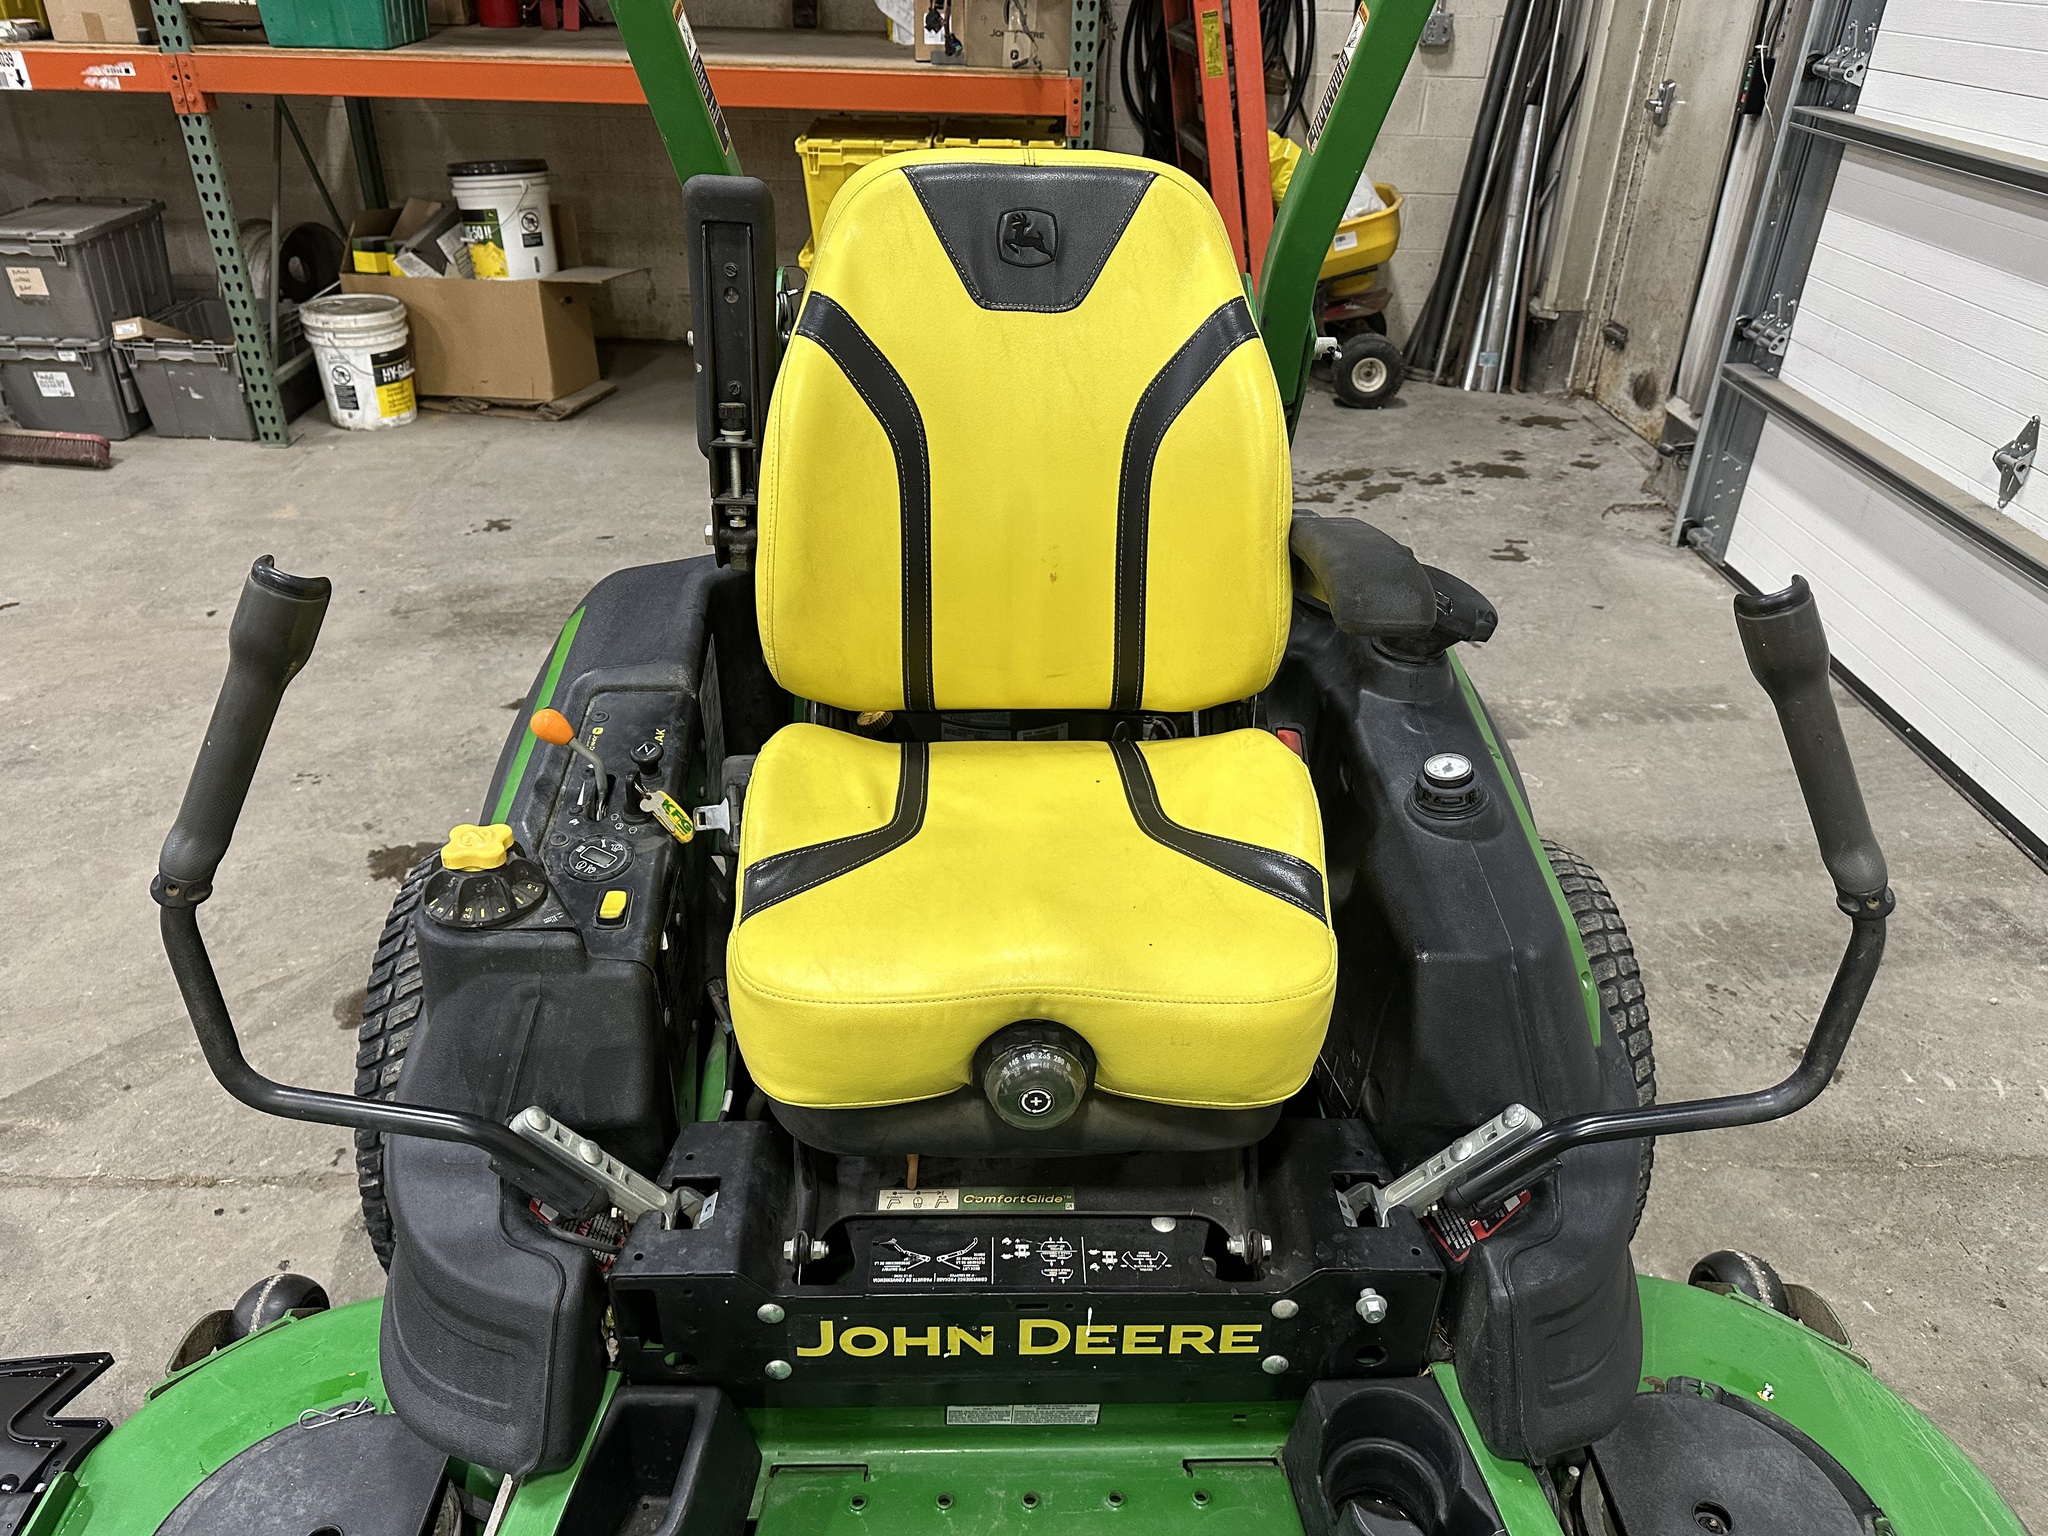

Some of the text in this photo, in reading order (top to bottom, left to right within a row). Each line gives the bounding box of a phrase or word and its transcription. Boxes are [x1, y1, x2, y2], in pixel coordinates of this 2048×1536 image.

[661, 799, 693, 833] KFG
[1008, 1057, 1020, 1068] 145
[1022, 1052, 1035, 1061] 190
[796, 1318, 1263, 1357] JOHN DEERE
